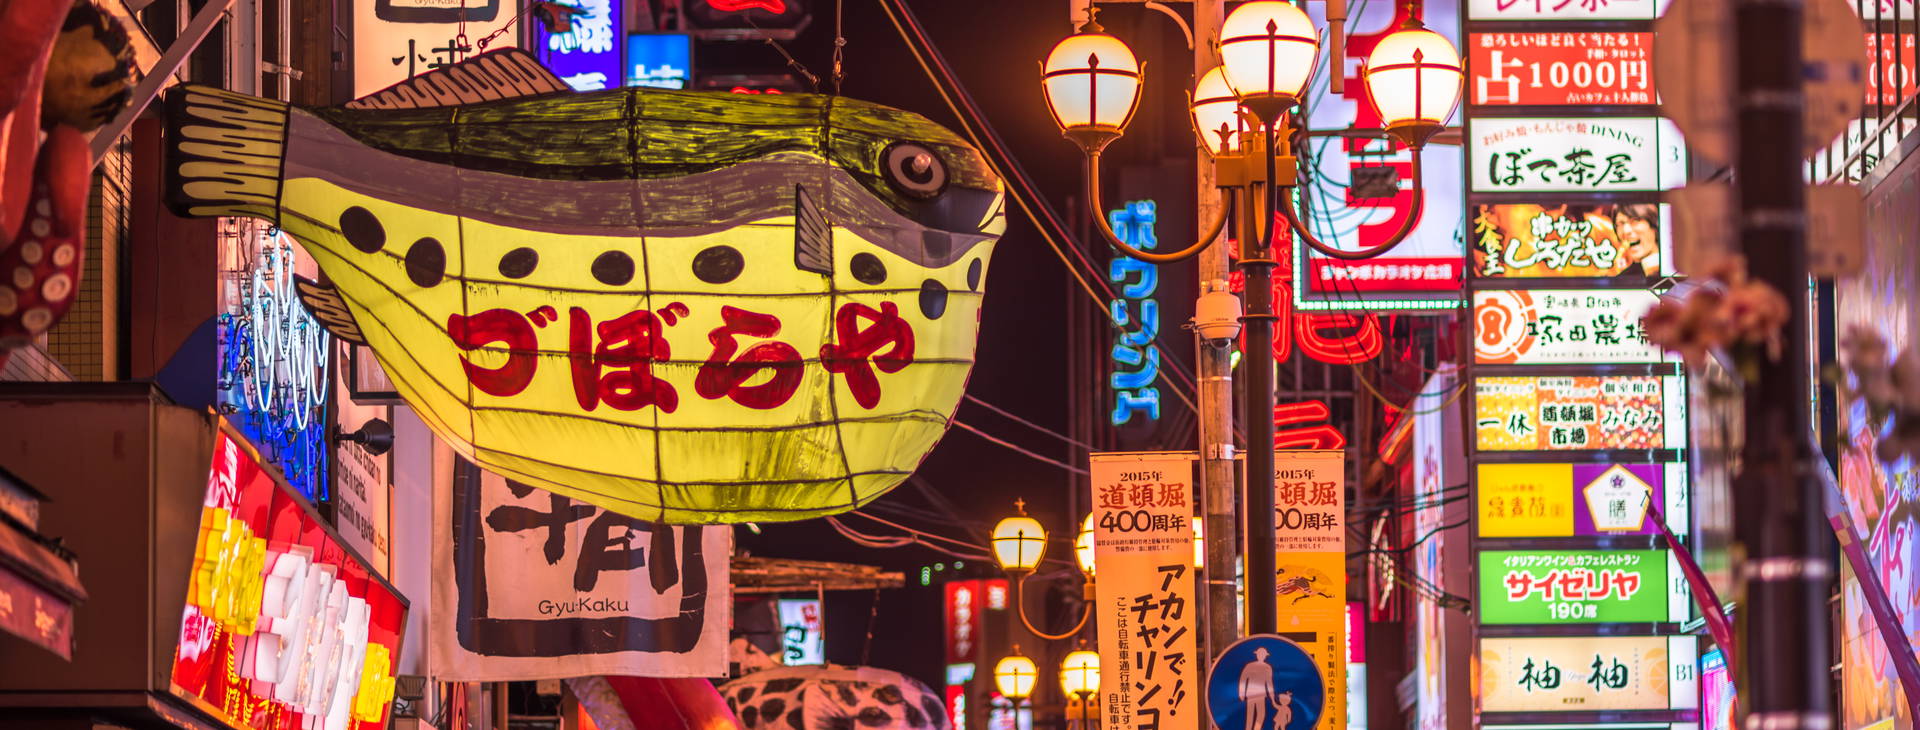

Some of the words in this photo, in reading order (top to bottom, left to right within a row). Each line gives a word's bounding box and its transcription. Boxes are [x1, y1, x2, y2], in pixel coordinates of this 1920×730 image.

[1477, 50, 1524, 105] 占
[1529, 59, 1648, 90] 1000円
[1591, 124, 1643, 148] DINING
[1489, 146, 1638, 187] ぼて茶屋
[447, 301, 915, 414] づぼらや
[1602, 409, 1660, 428] みなみ
[1120, 471, 1163, 482] 2015年
[1099, 482, 1187, 510] 道頓堀
[1275, 481, 1338, 508] 頓堀
[1099, 510, 1187, 534] 400周年
[1275, 508, 1338, 532] 00周年
[1505, 570, 1640, 600] サイゼリヤ
[1548, 602, 1598, 620] 190席
[1517, 656, 1562, 693] 柚
[1586, 653, 1630, 693] 柚
[1676, 663, 1694, 681] B1
